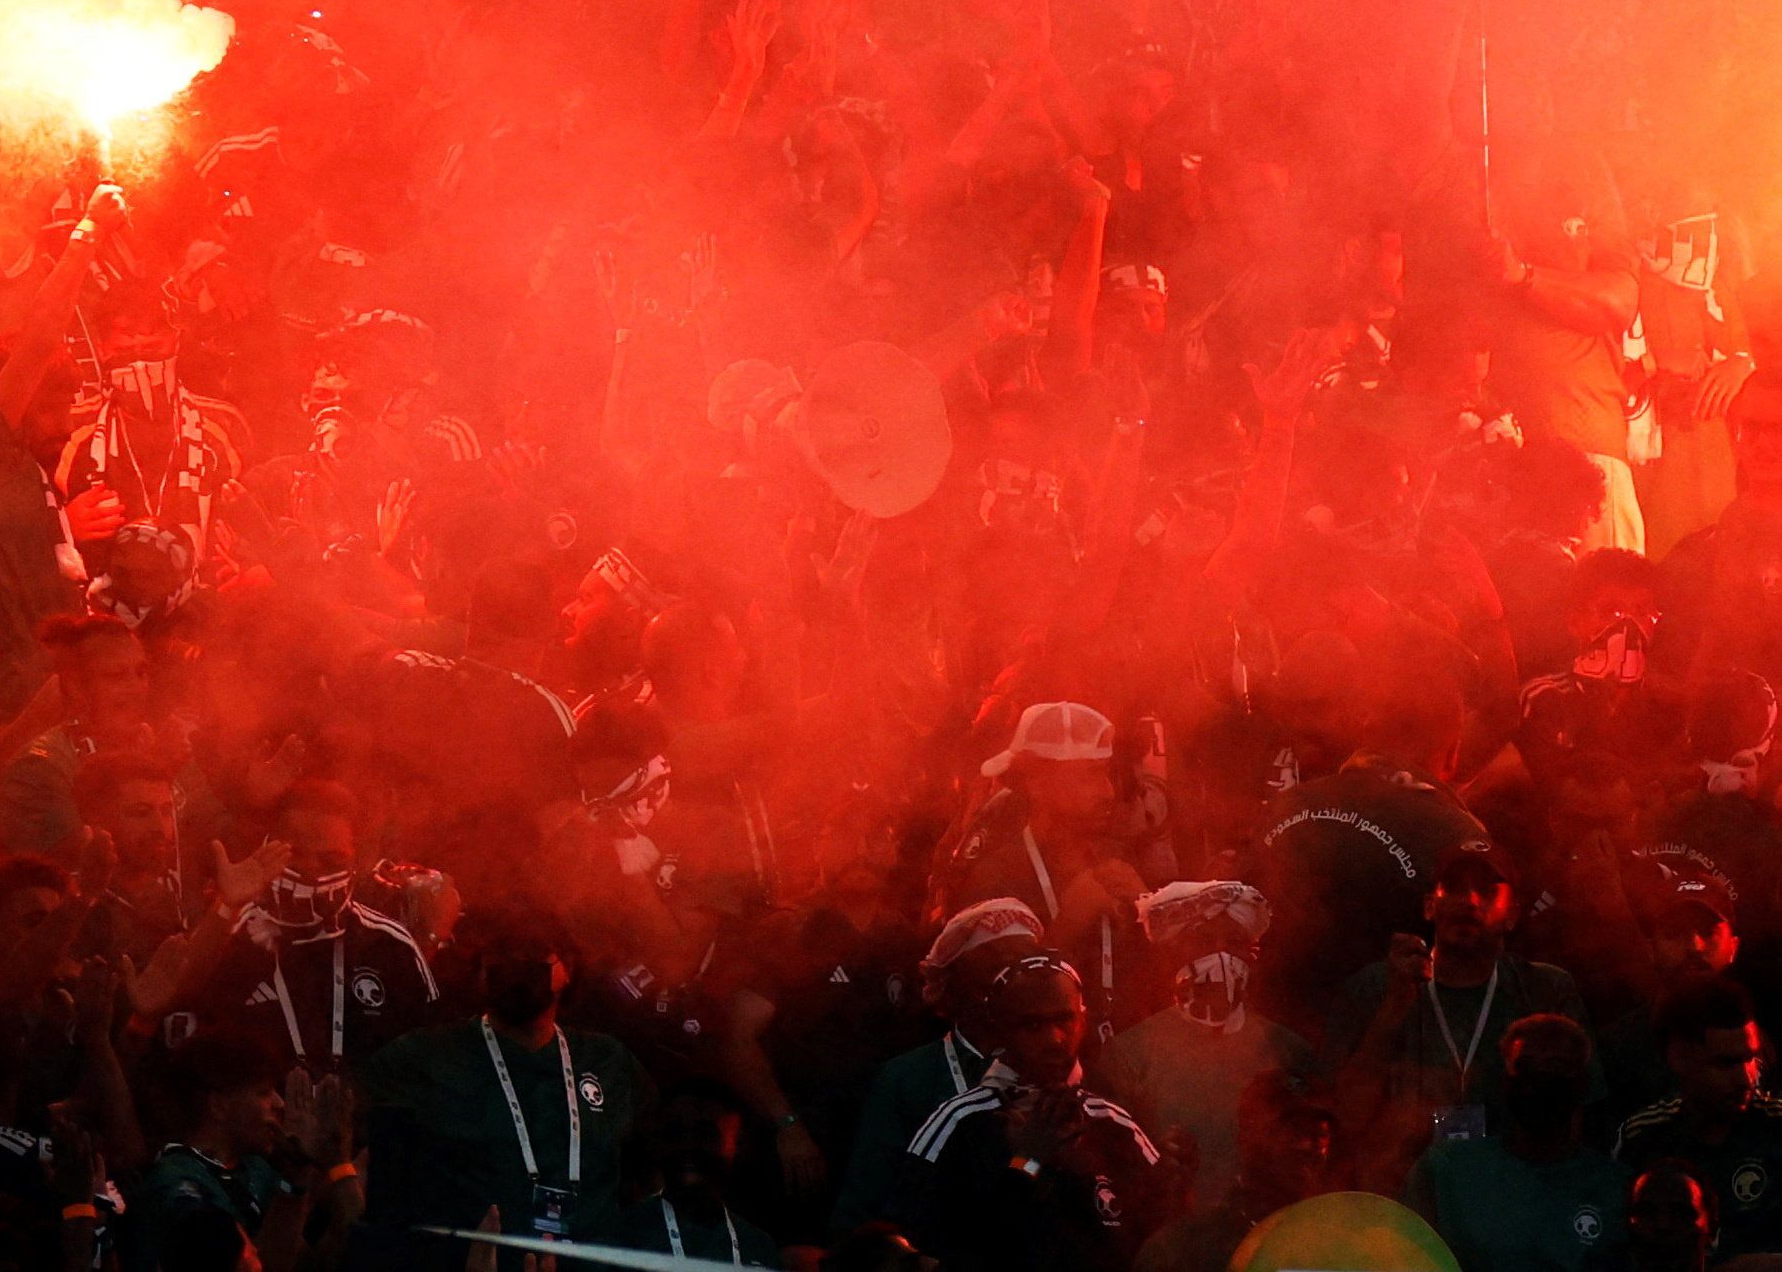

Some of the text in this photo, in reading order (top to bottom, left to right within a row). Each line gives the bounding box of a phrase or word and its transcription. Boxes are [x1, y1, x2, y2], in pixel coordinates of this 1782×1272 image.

[1310, 809, 1358, 825] المنتخب
[1356, 817, 1393, 845] جمهور
[1389, 843, 1417, 878] مجلس
